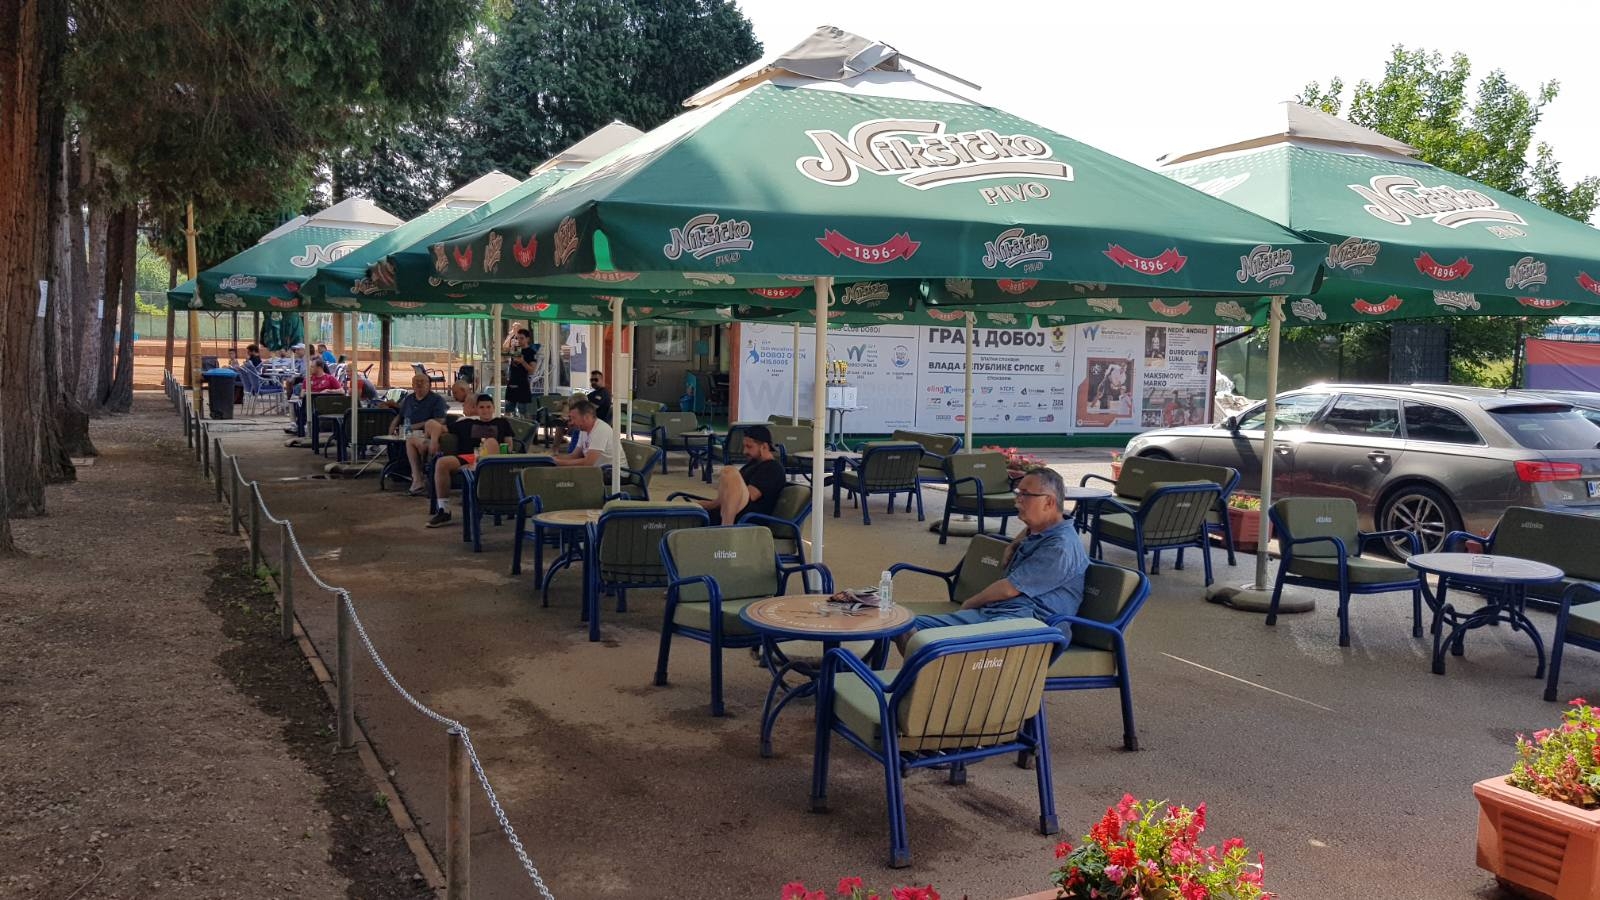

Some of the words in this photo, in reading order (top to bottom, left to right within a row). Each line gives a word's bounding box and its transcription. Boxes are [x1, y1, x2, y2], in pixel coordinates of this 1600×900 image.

[978, 181, 1052, 206] PIVO
[984, 330, 1046, 348] ДОБОЈ
[928, 361, 961, 371] ВЛАДА
[1014, 364, 1045, 373] СРПСКЕ
